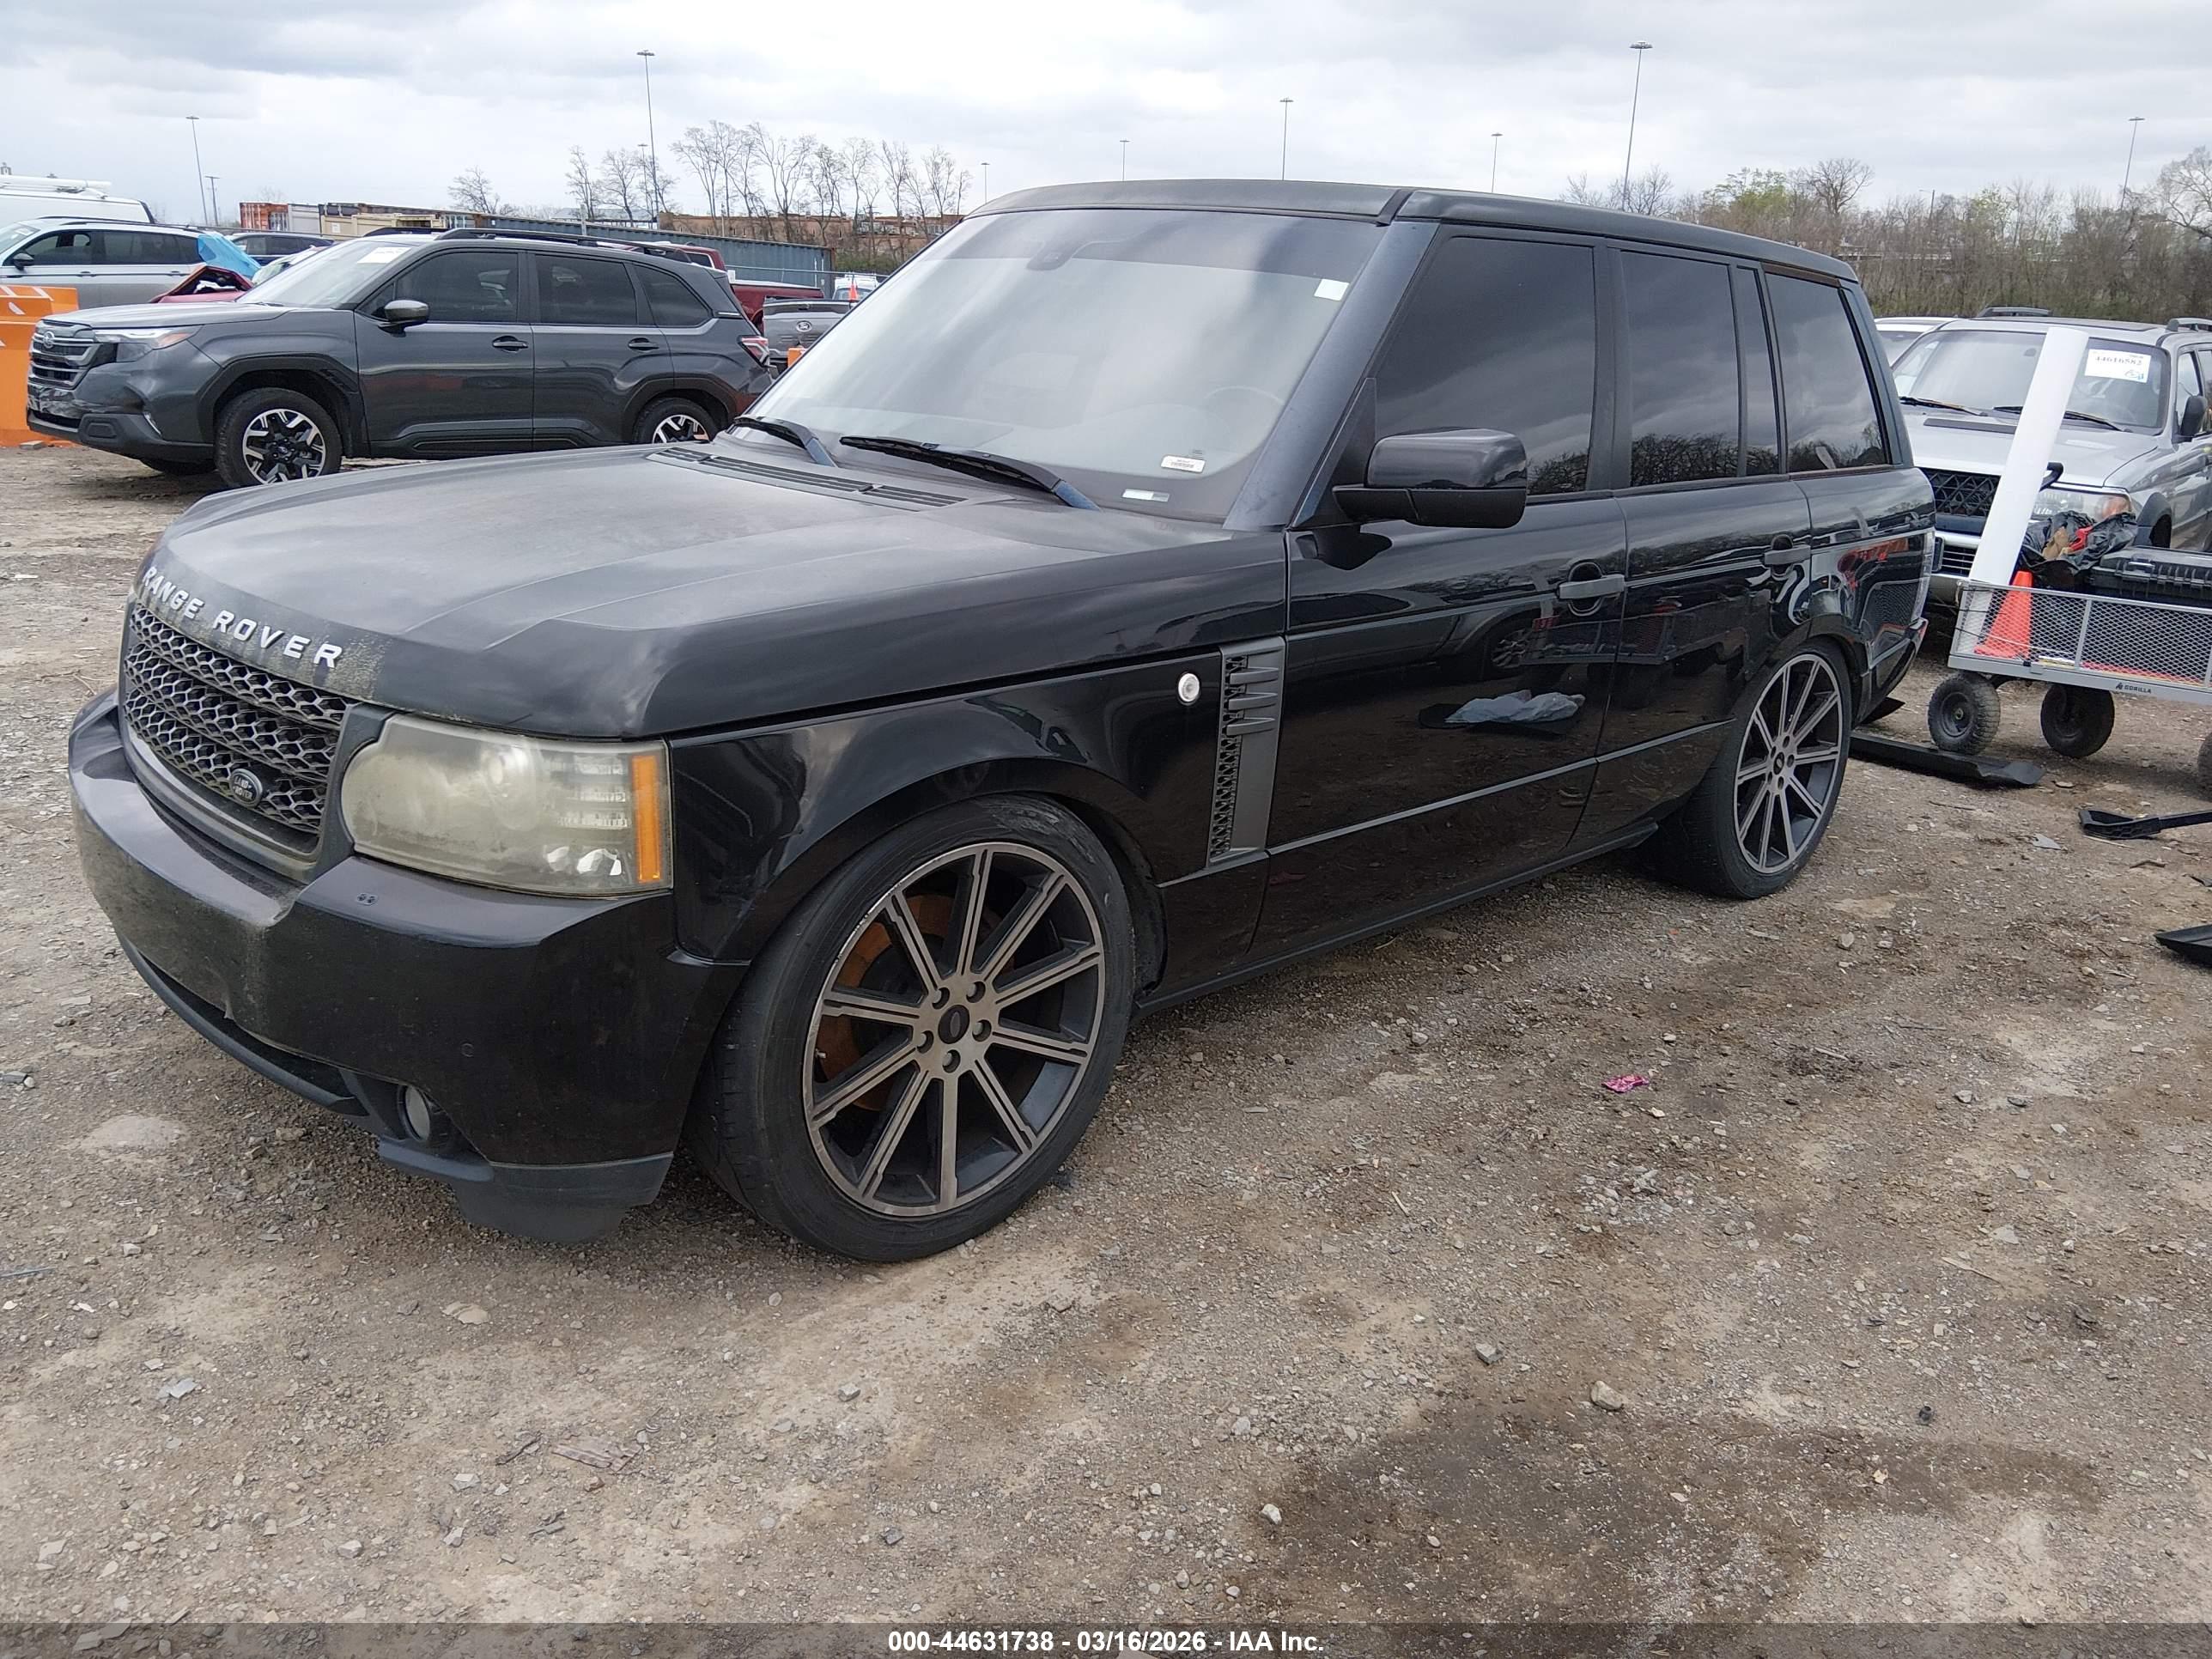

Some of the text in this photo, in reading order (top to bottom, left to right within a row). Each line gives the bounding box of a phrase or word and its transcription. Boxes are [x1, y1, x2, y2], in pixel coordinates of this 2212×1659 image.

[143, 566, 343, 668] RANGE ROVER
[2124, 684, 2152, 694] GORILLA
